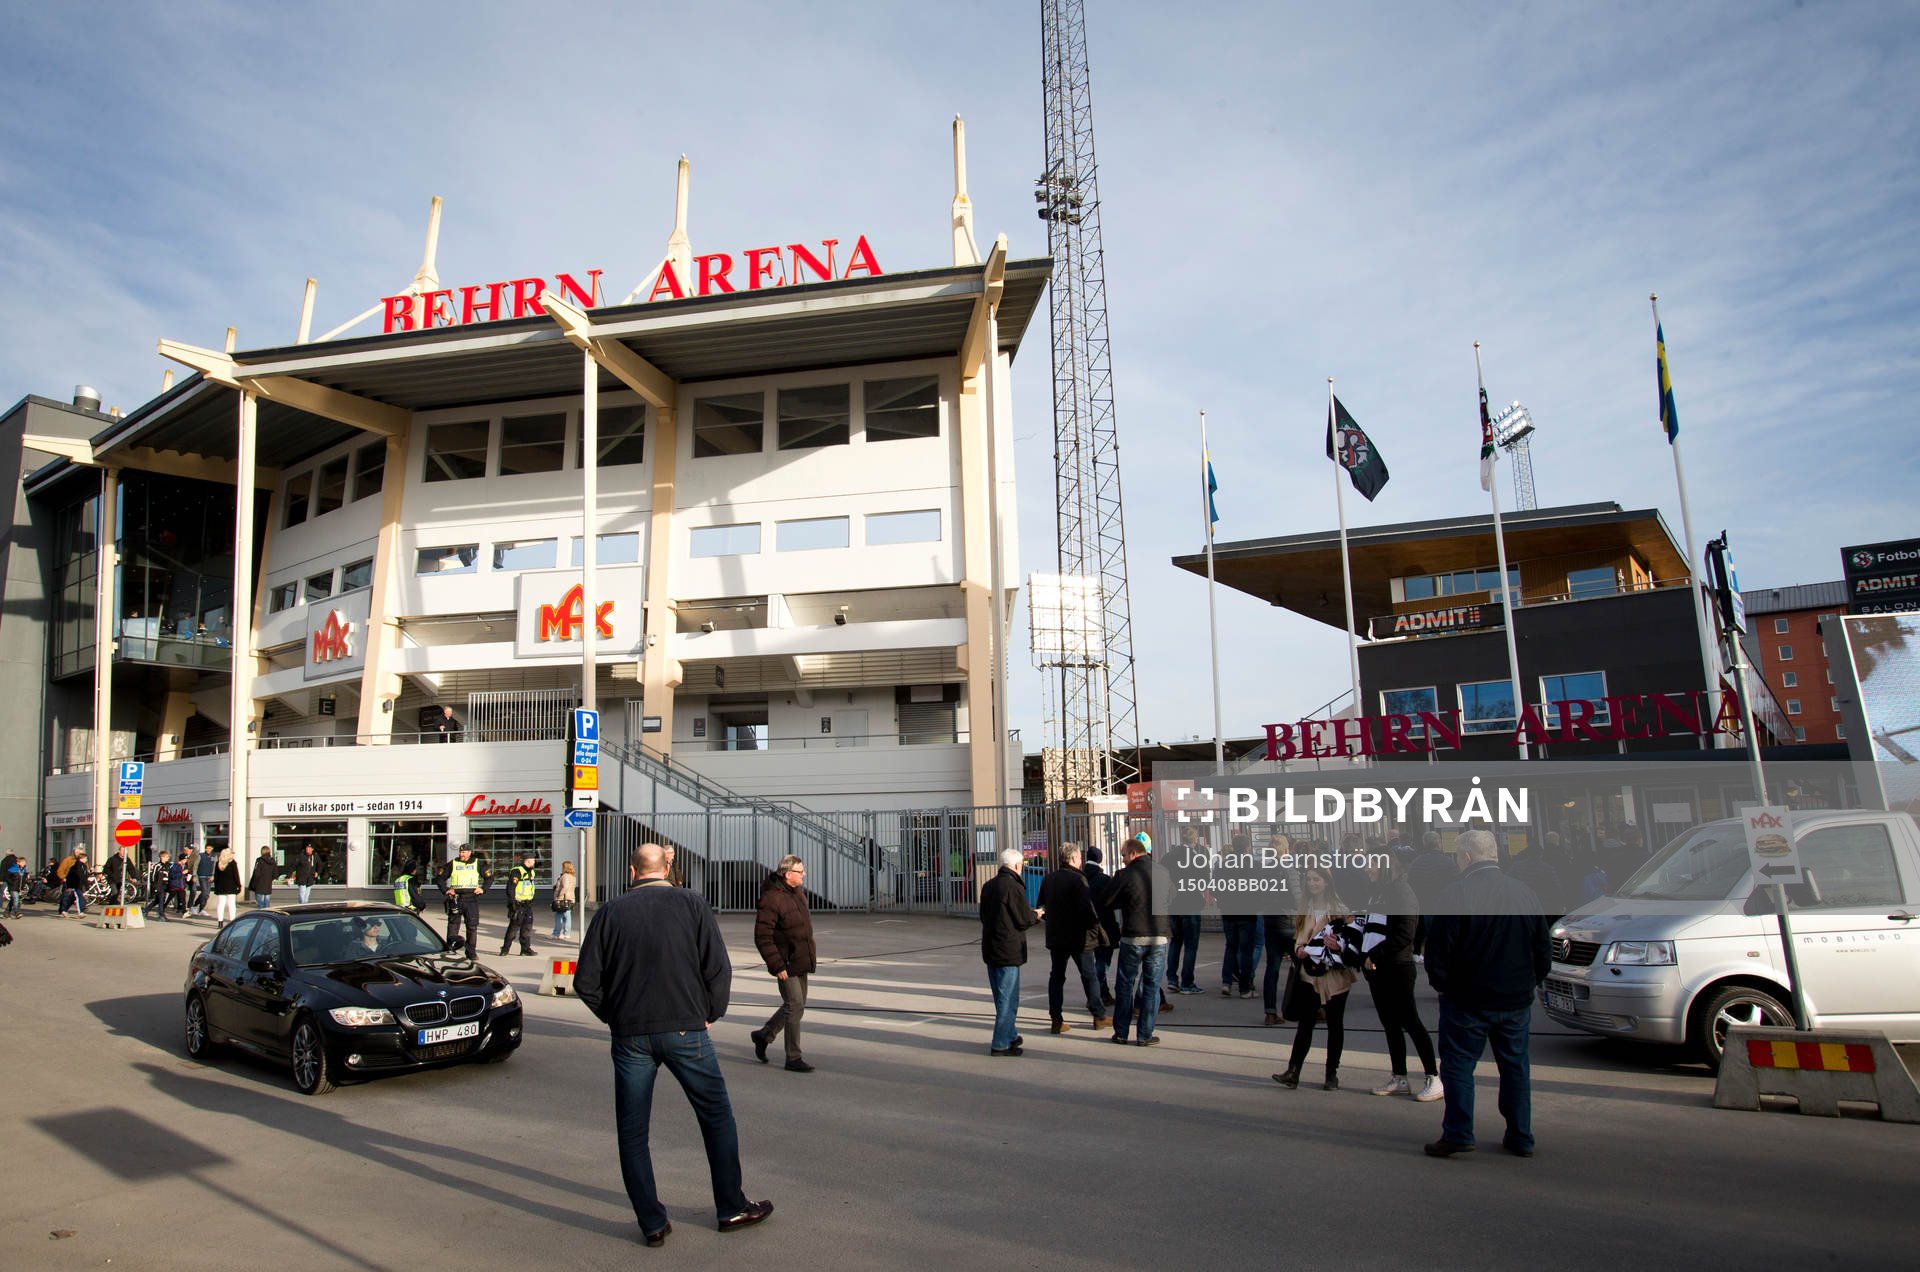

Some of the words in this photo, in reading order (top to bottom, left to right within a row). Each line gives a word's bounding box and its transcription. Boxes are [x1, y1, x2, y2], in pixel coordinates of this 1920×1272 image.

[380, 268, 604, 334] BEHRN
[648, 234, 884, 302] ARENA
[539, 583, 615, 642] MAX
[1861, 602, 1917, 613] SALON
[1394, 607, 1468, 632] ADMIT
[312, 608, 353, 664] MAX
[322, 701, 333, 714] E
[582, 713, 594, 737] P
[1261, 708, 1462, 762] BEHRN
[1509, 688, 1761, 748] ARENA
[126, 763, 138, 779] P
[156, 805, 190, 824] Lindells
[287, 801, 297, 812] Vi
[299, 801, 328, 812] älskar
[330, 801, 354, 813] sport
[366, 800, 395, 812] sedan
[398, 800, 423, 811] 1914
[463, 794, 551, 815] Lindells
[1749, 812, 1784, 829] MAX
[426, 1029, 449, 1043] HWP
[457, 1024, 477, 1036] 480
